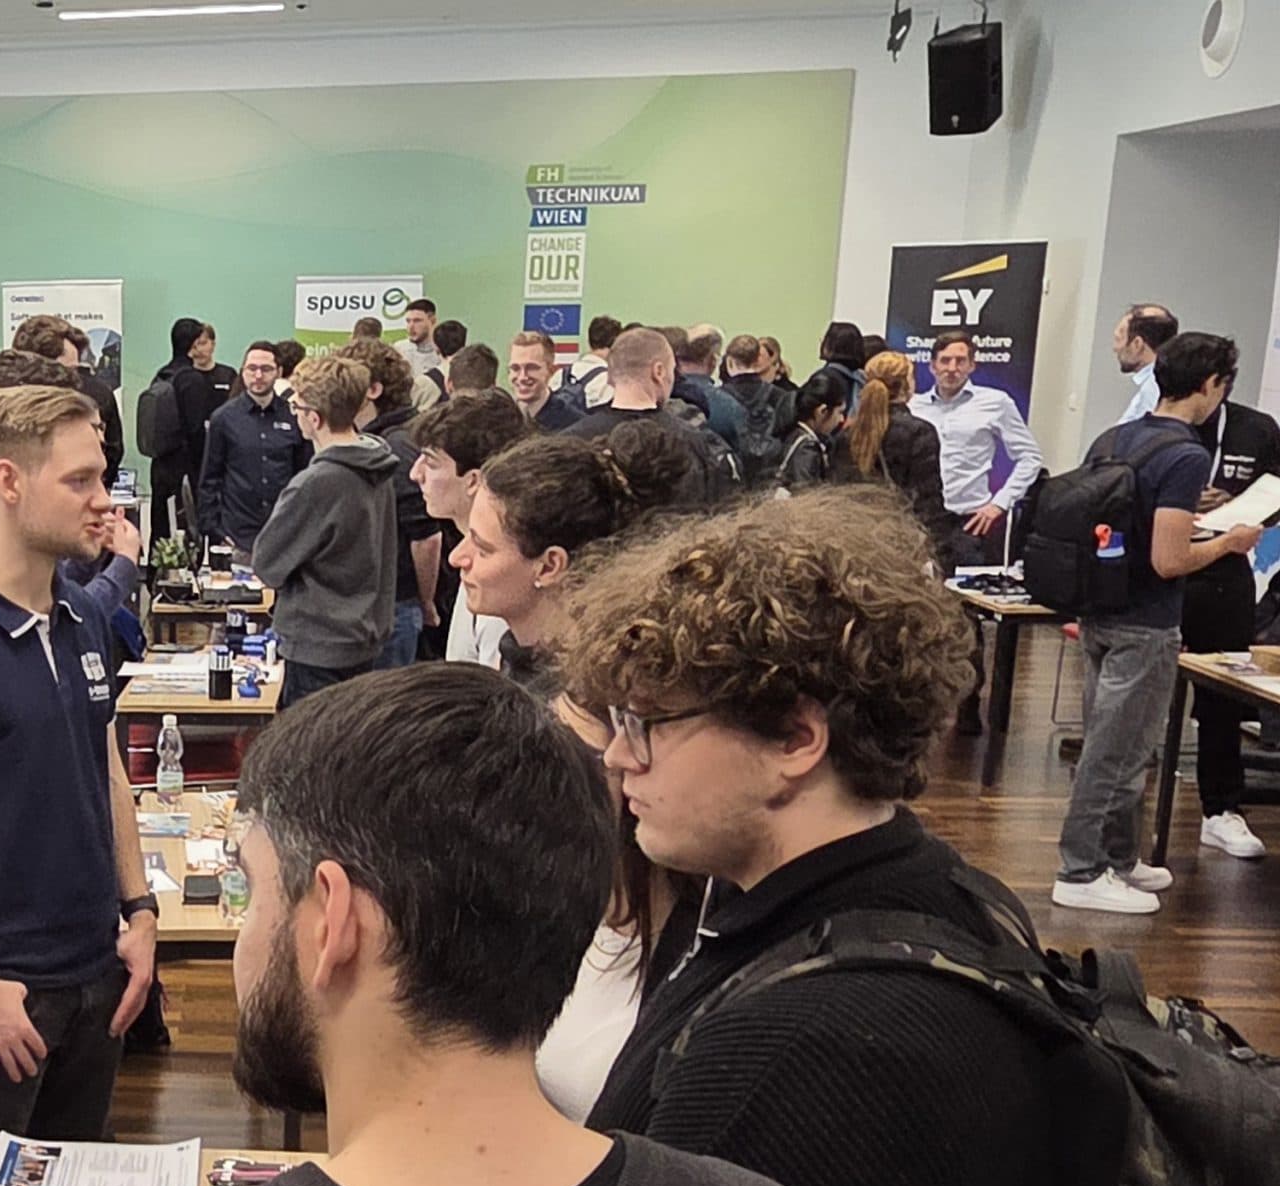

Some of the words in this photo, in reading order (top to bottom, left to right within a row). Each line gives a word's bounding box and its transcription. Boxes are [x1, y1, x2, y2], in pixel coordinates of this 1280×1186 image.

[536, 168, 560, 181] FH
[536, 186, 641, 203] TECHNIKUM
[536, 209, 582, 224] WIEN
[530, 237, 582, 252] CHANGE
[529, 255, 580, 281] OUR
[307, 295, 375, 315] spusu
[930, 289, 993, 326] EY
